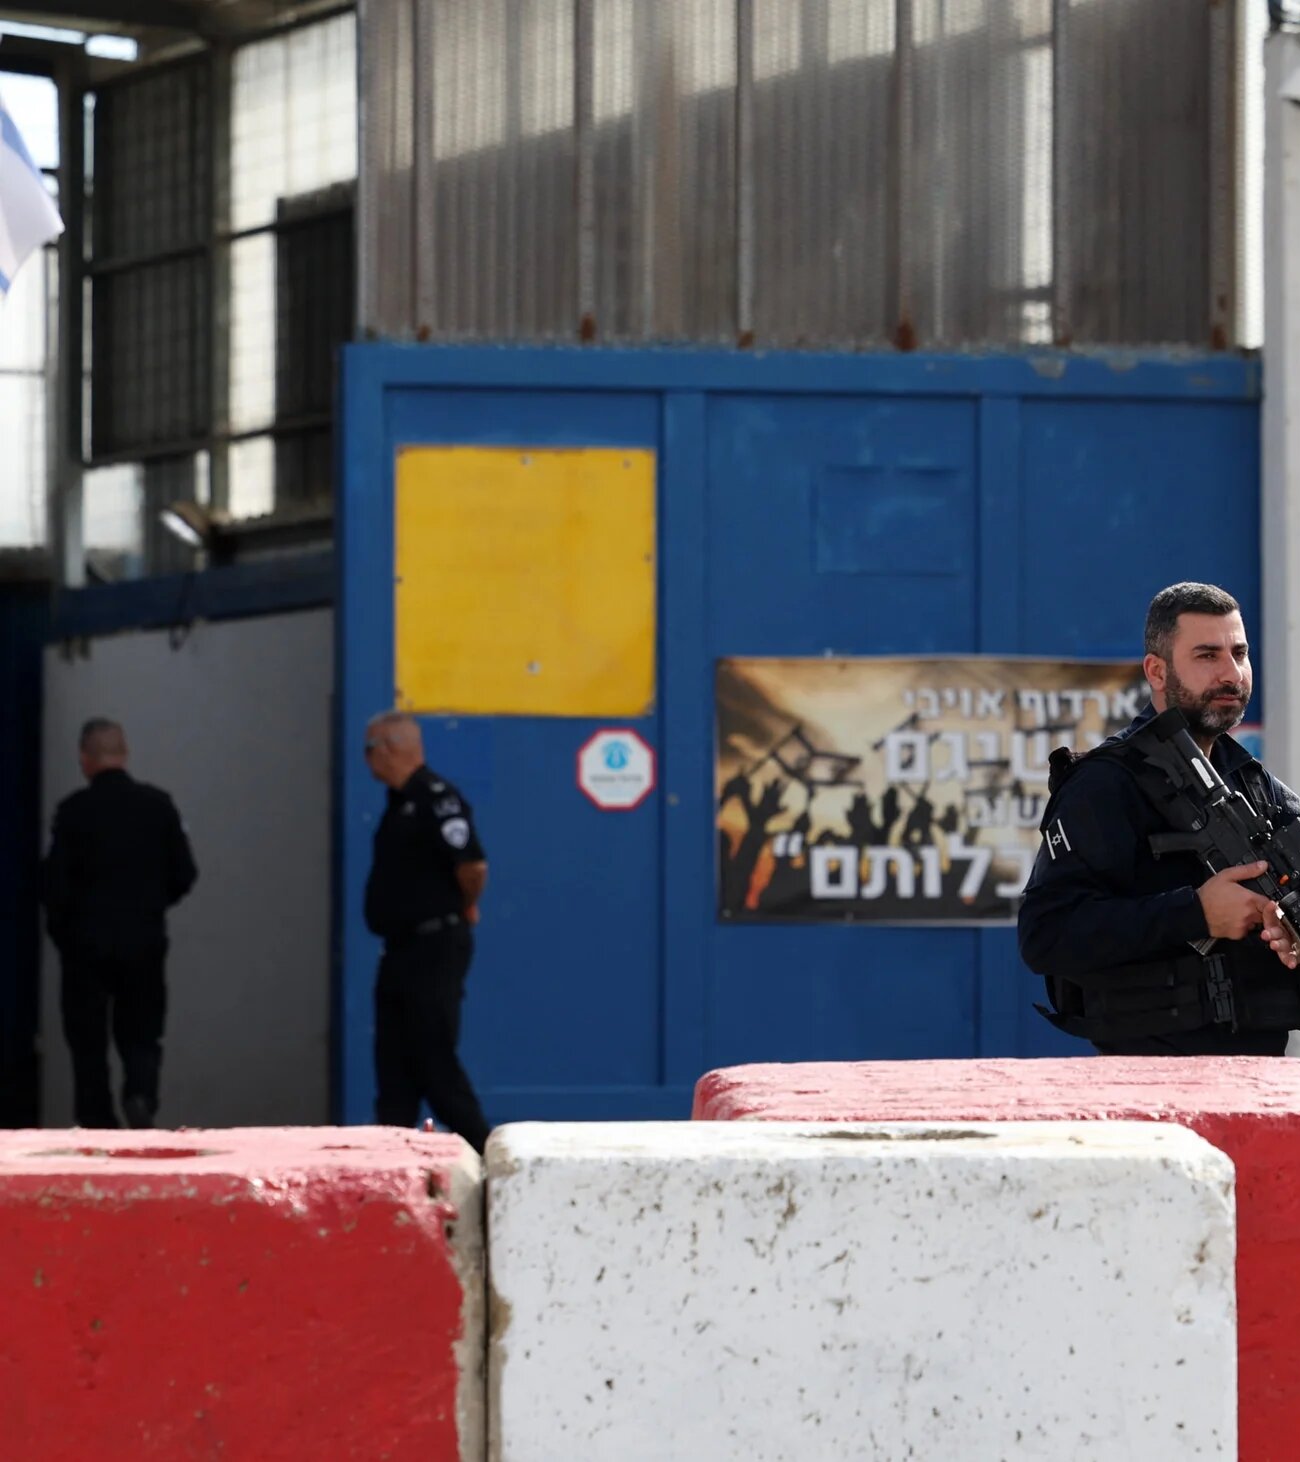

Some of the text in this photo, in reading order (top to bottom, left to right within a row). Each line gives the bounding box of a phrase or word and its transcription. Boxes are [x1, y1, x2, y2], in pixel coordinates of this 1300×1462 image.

[904, 687, 1006, 720] אויבי
[884, 730, 1105, 783] שיגם
[967, 795, 1047, 829] שוב
